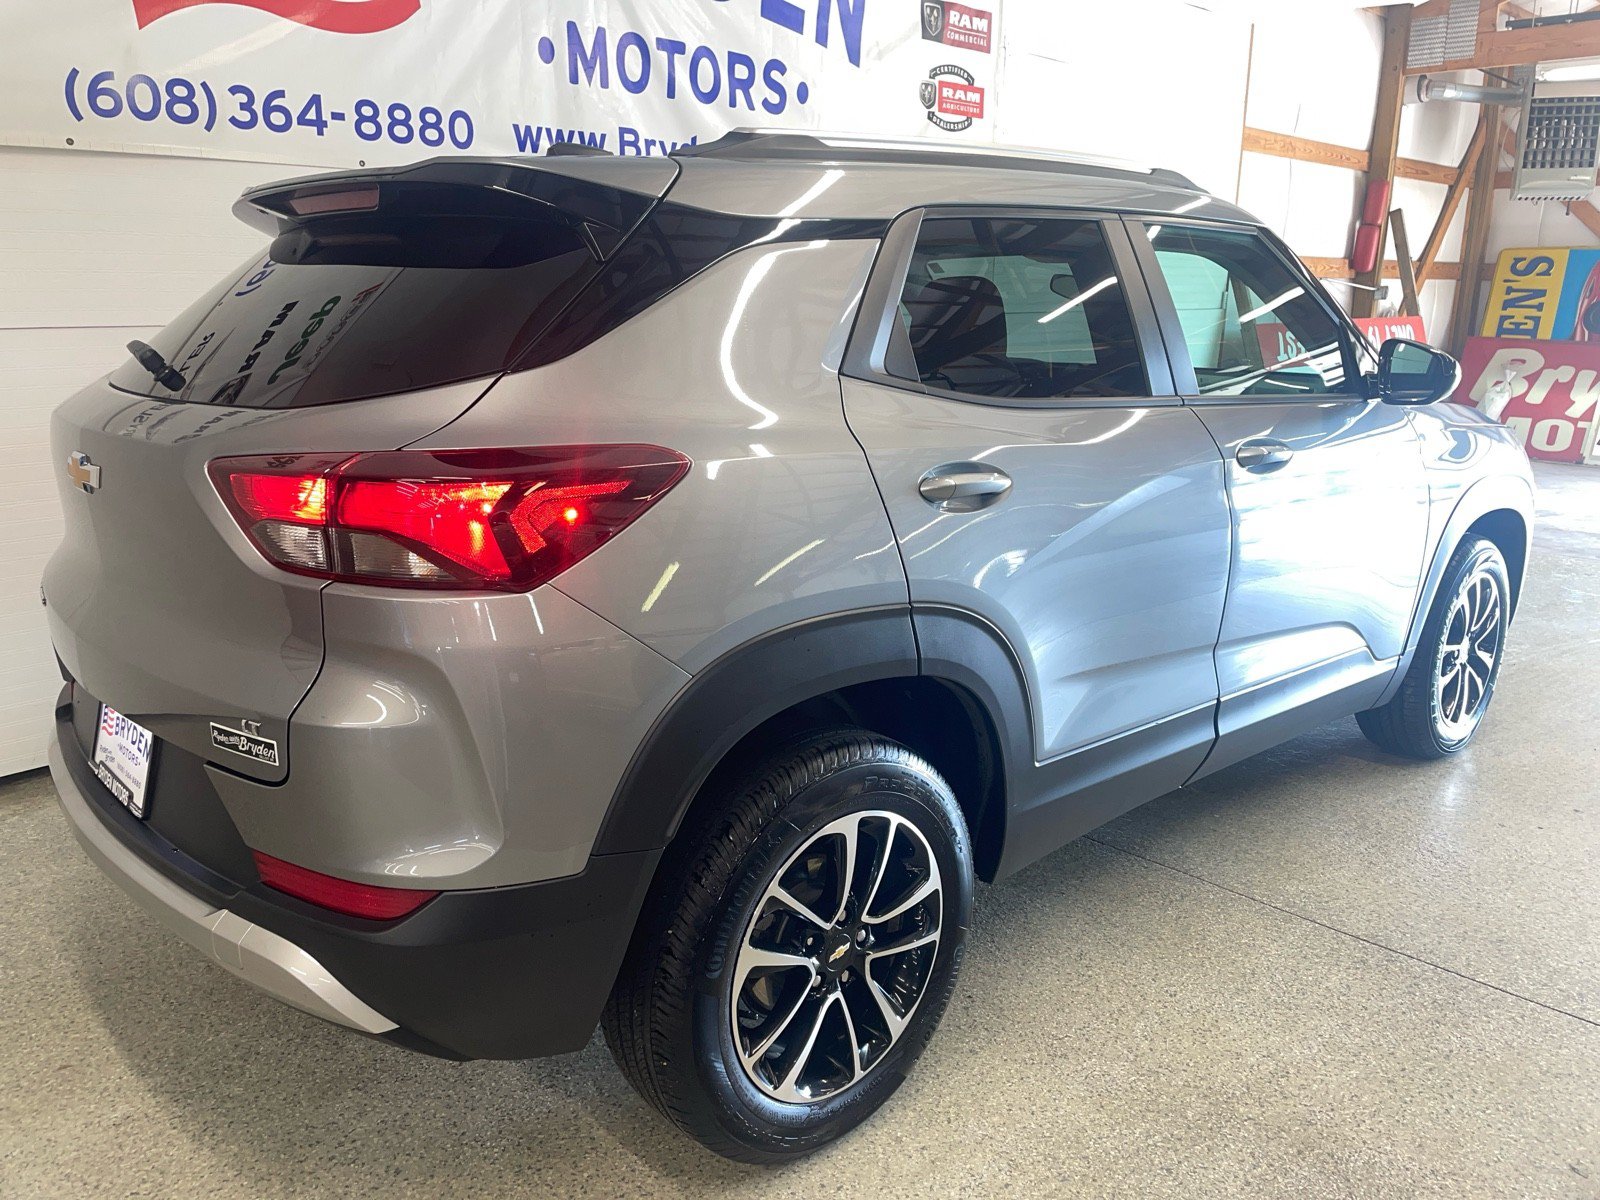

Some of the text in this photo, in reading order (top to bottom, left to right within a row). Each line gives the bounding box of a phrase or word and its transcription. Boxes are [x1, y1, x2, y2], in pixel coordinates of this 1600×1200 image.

[949, 10, 989, 32] RAM
[946, 30, 988, 47] COMMERCIAL
[565, 20, 788, 116] MOTORS
[936, 65, 969, 80] CERTIFIED
[942, 86, 981, 103] RAM
[942, 102, 981, 115] AGRICULTURE
[932, 113, 970, 131] DEALERSHIP
[241, 719, 262, 736] LT
[114, 715, 152, 763] BRYDEN
[239, 736, 275, 759] Bryden
